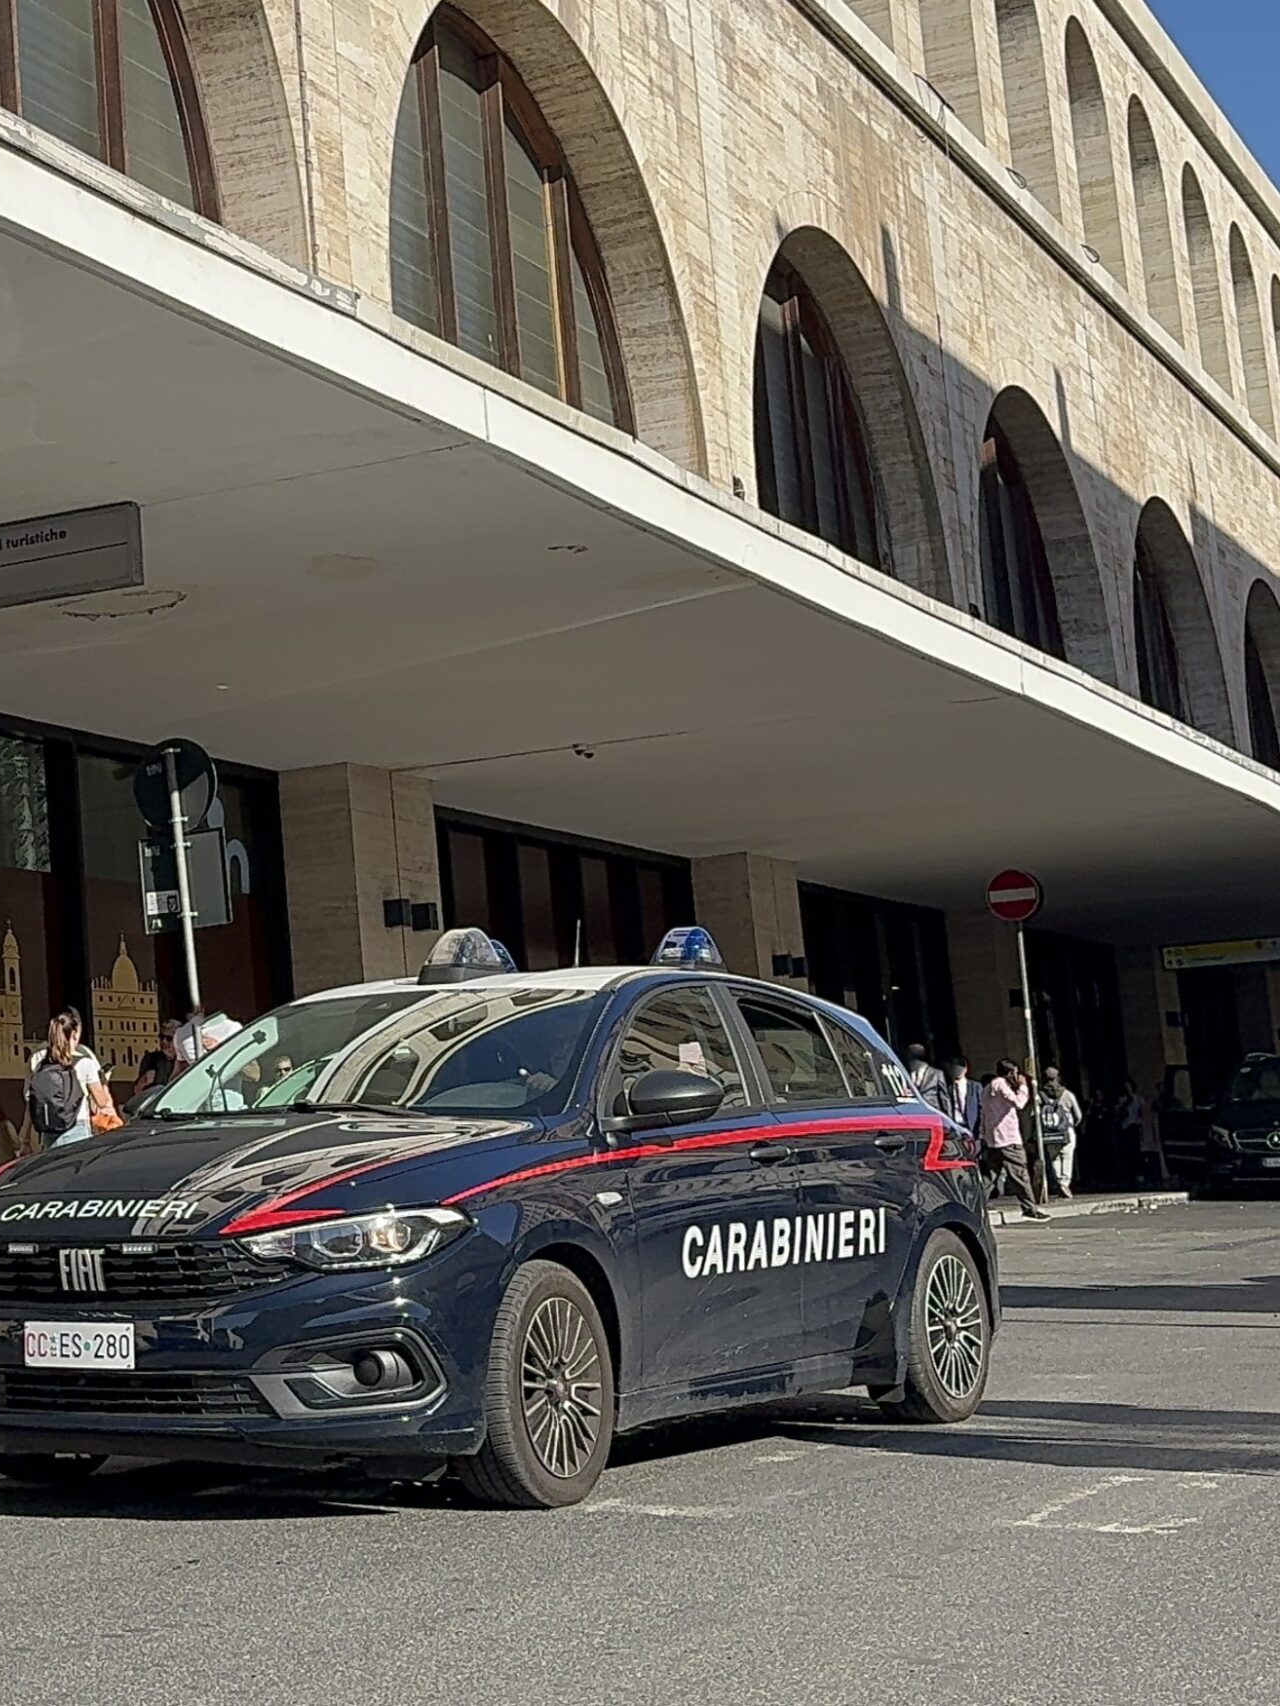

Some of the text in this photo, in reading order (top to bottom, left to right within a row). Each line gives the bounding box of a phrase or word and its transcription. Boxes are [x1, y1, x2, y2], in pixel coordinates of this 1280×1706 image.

[6, 528, 67, 549] turistiche
[0, 1200, 200, 1222] CARABINIERI
[682, 1207, 886, 1279] CARABINIERI
[58, 1248, 107, 1292] FIAT
[26, 1332, 48, 1358] CC
[59, 1332, 82, 1358] ES
[93, 1333, 130, 1359] 280
